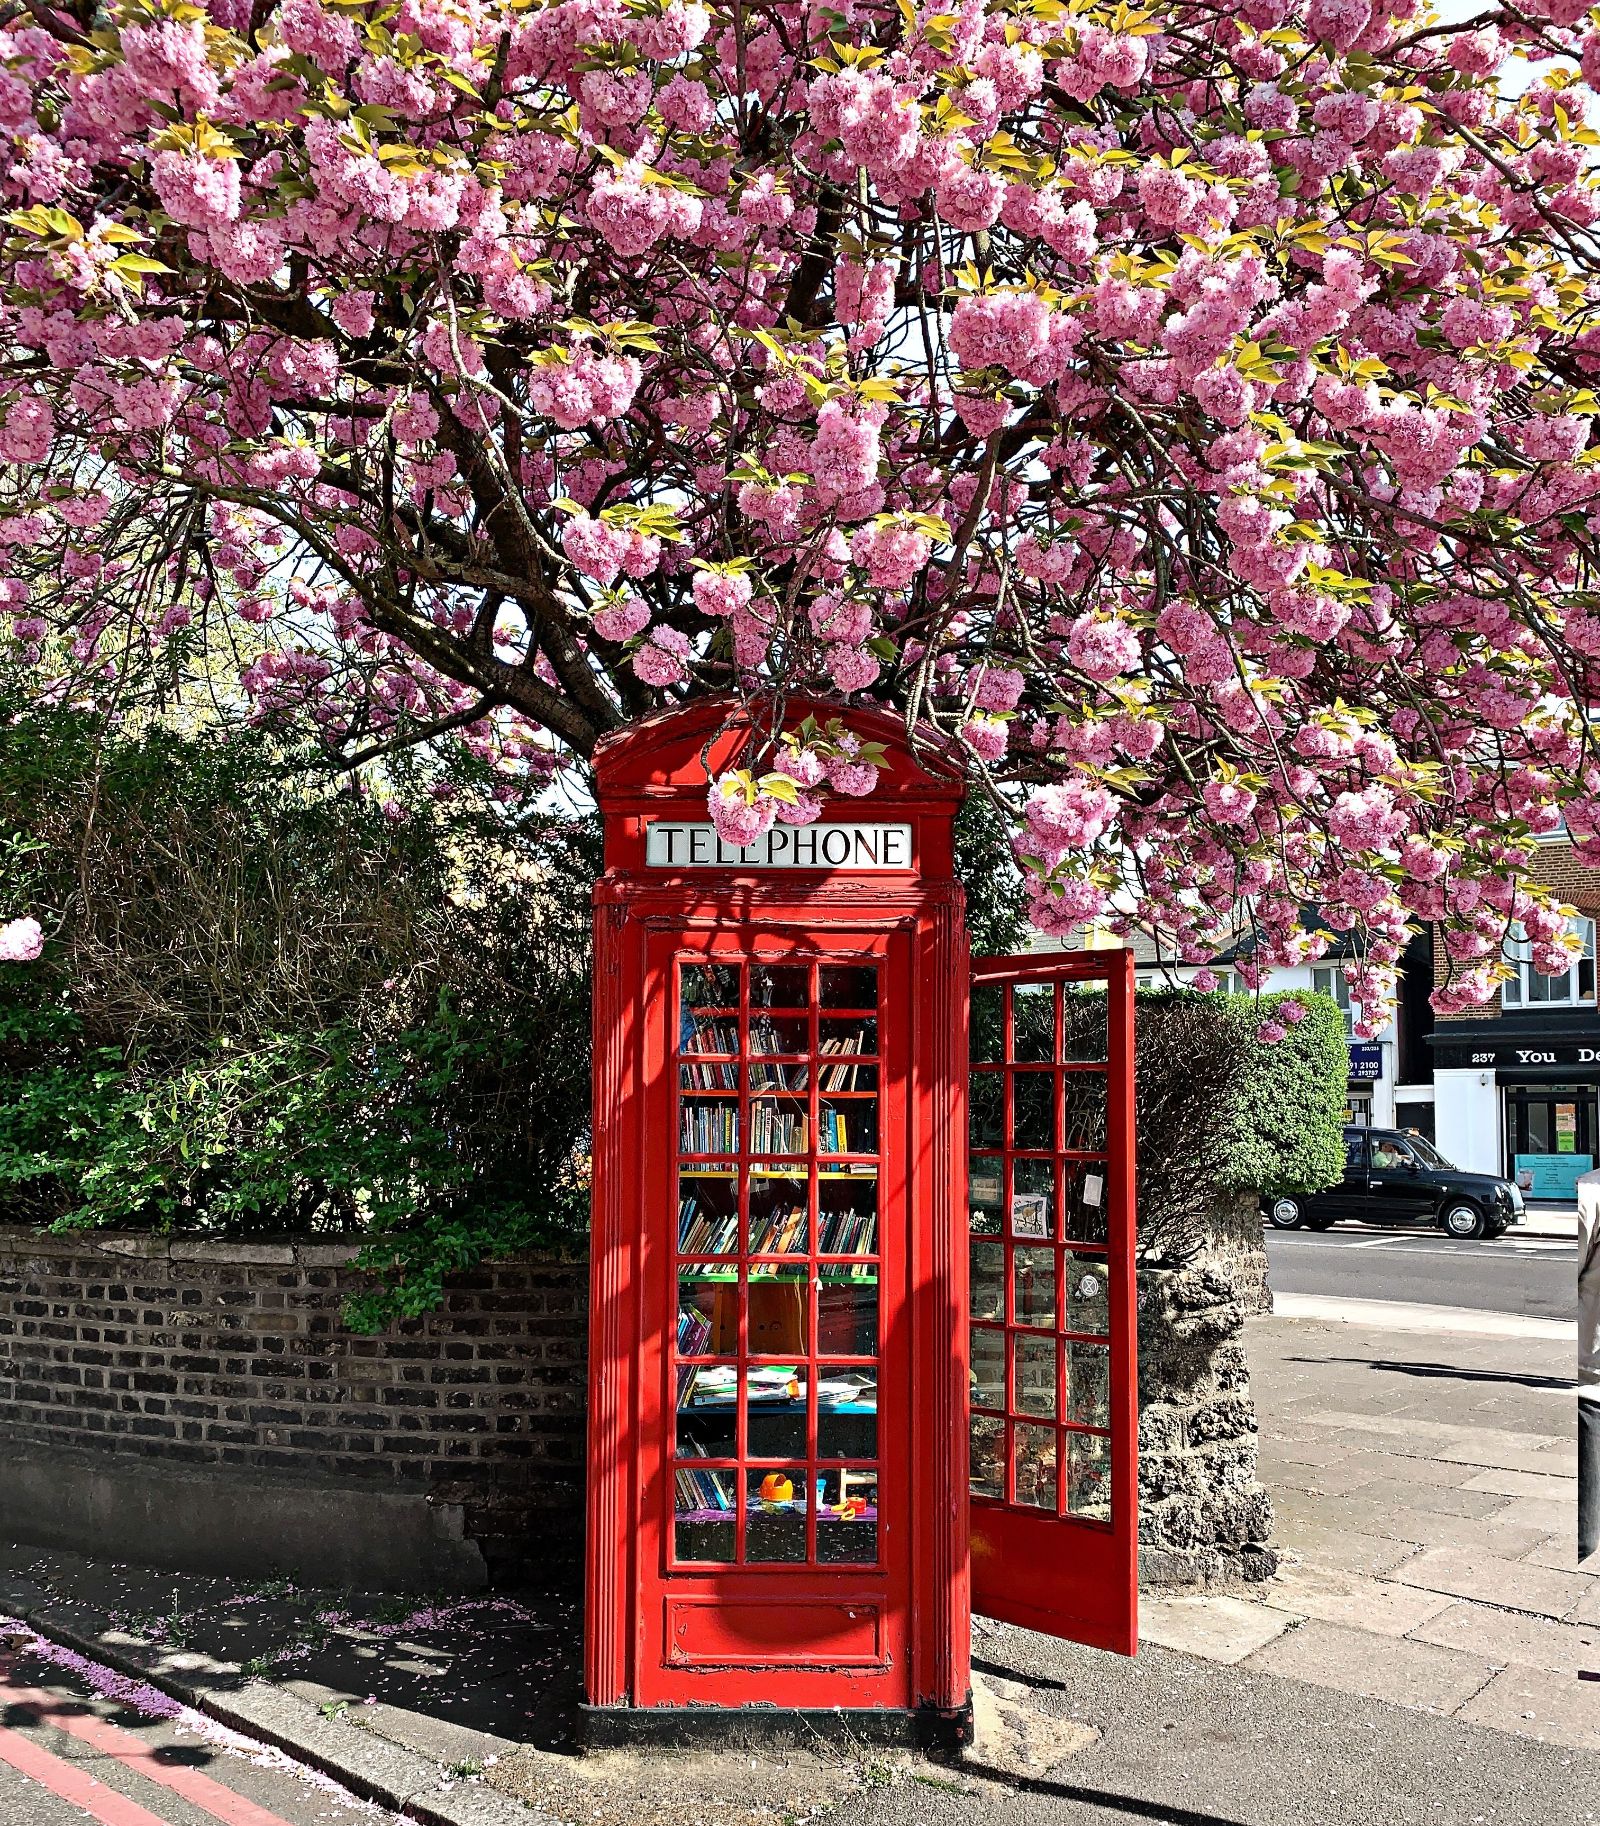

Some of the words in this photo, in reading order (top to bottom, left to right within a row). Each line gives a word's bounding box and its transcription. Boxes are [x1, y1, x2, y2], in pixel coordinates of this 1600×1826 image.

[656, 829, 905, 865] TELEPHONE
[1472, 1053, 1496, 1063] 237
[1516, 1050, 1557, 1063] You
[1359, 1061, 1379, 1069] 2100
